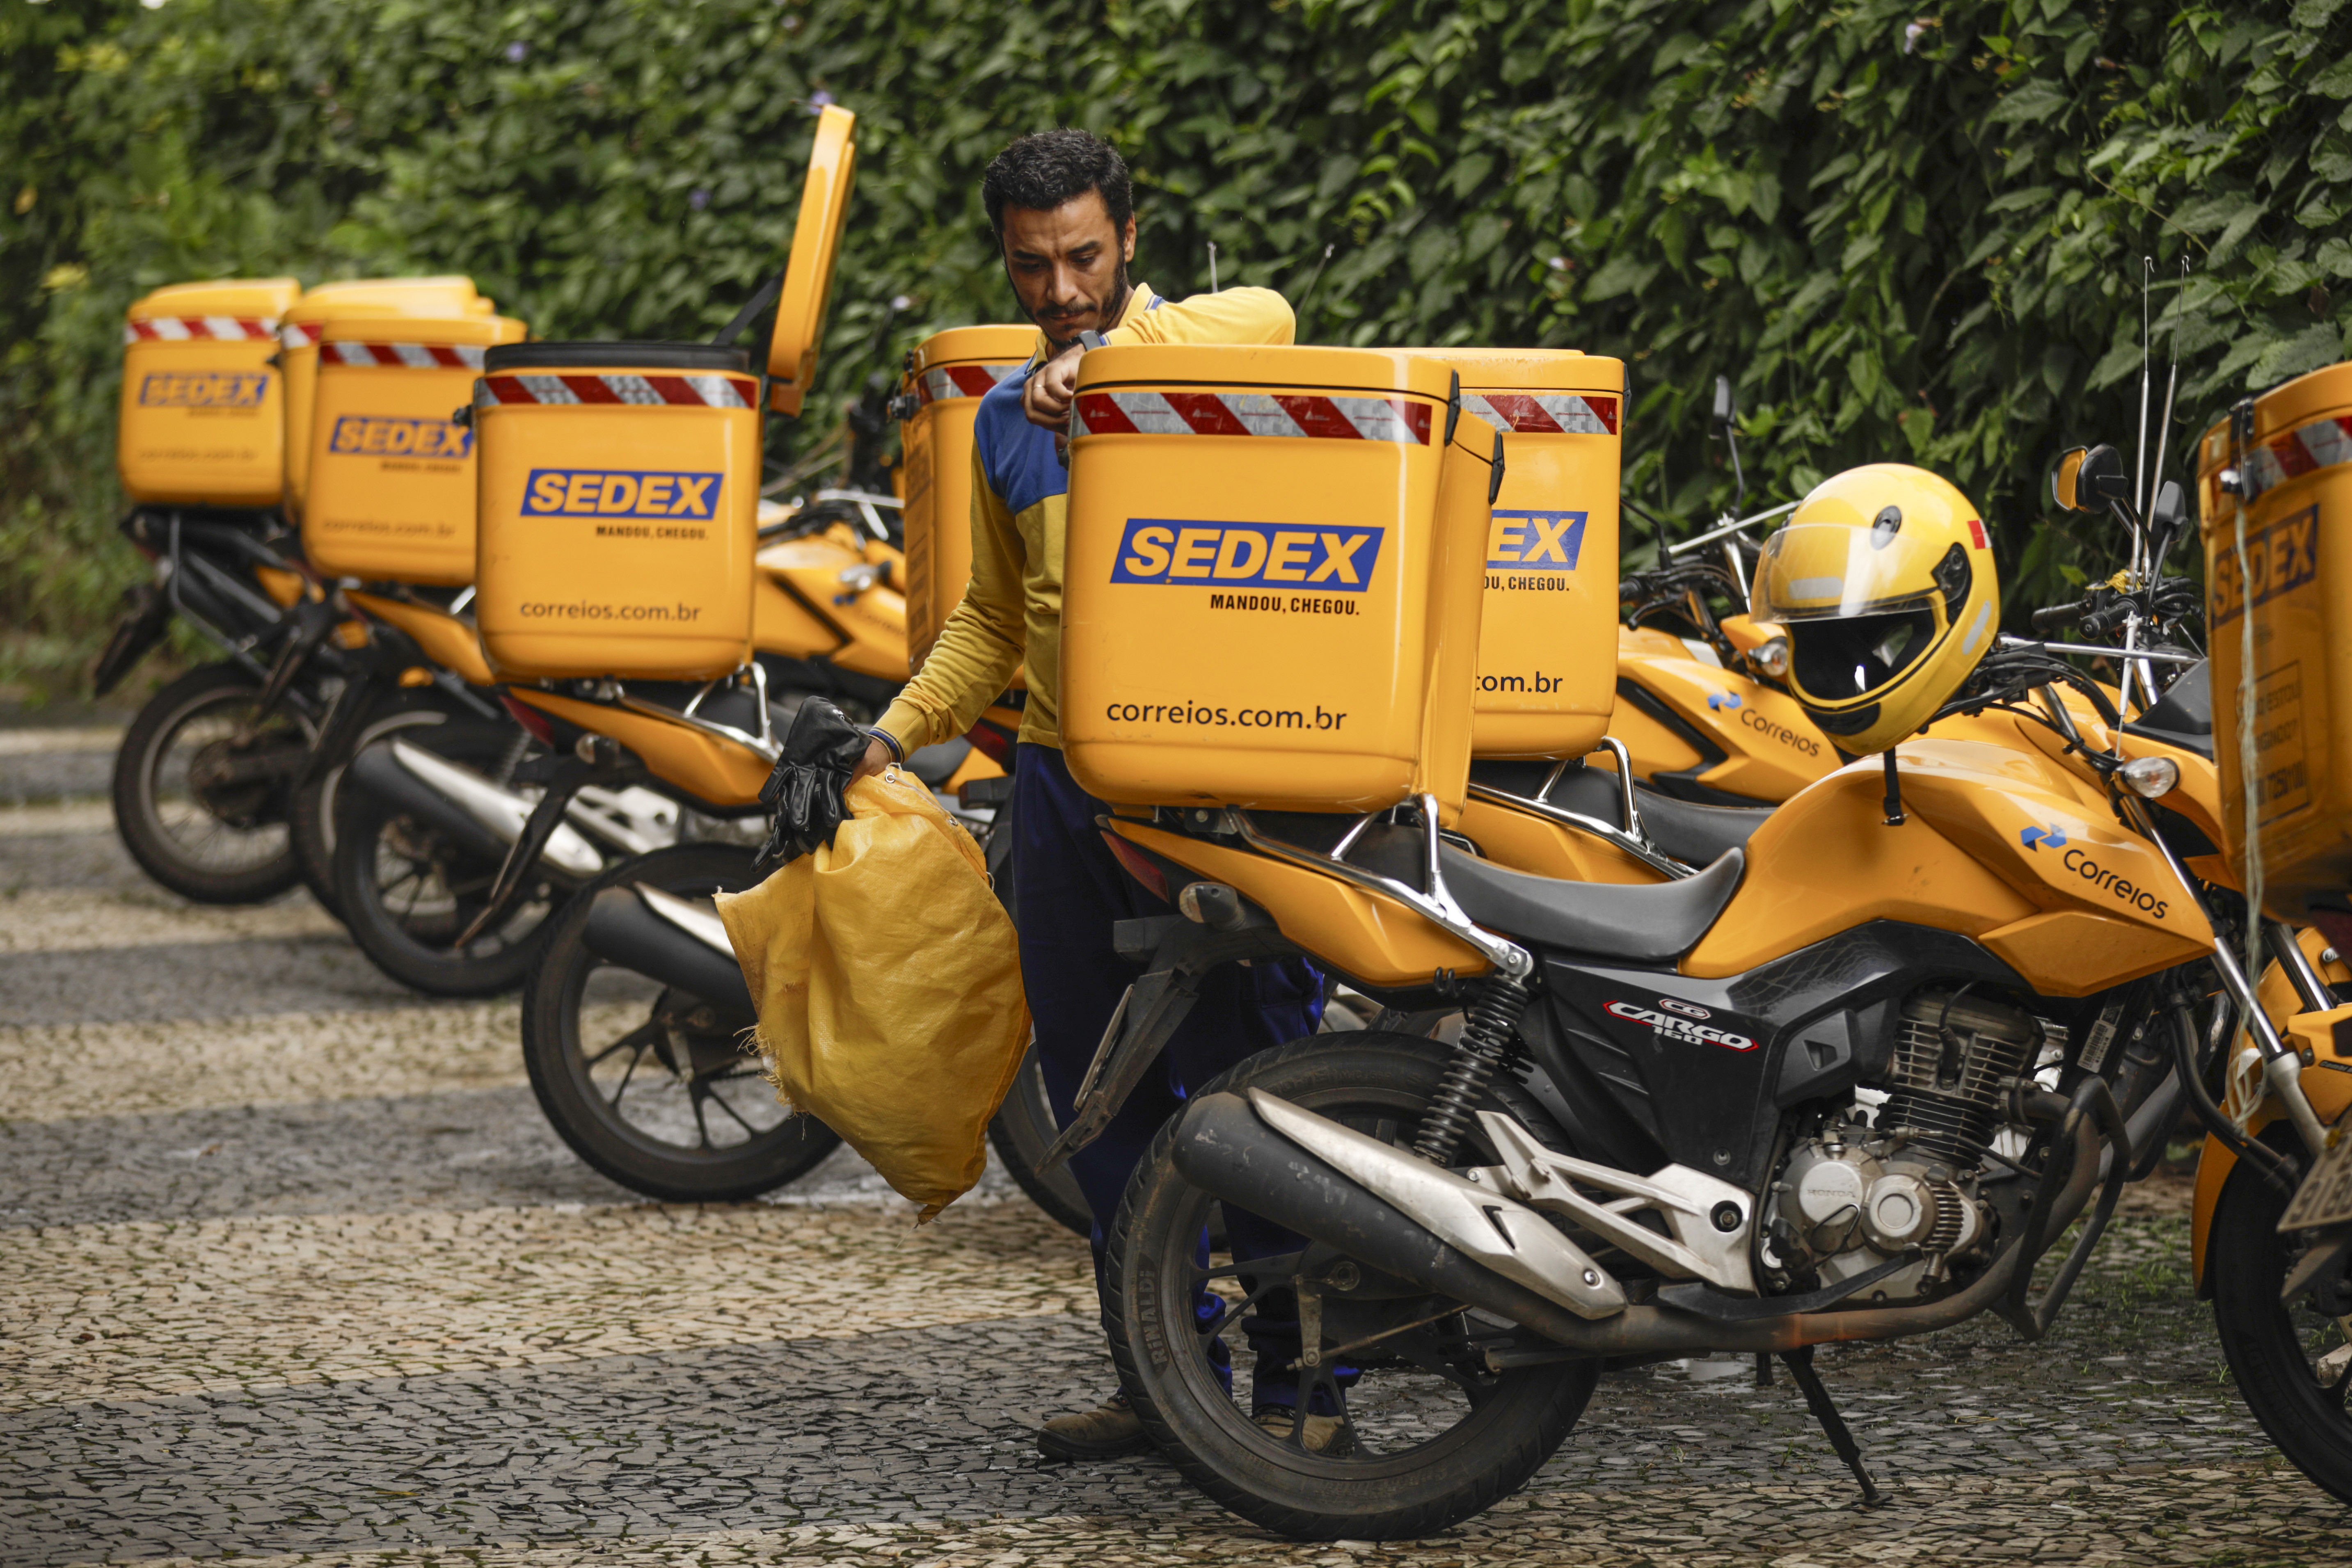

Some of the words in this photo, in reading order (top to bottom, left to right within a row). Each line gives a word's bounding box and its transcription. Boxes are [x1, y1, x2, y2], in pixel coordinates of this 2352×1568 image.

[336, 420, 469, 455] SEDEX
[529, 473, 716, 516] SEDEX
[596, 526, 654, 540] MANDOU,
[657, 527, 709, 541] CHEGOU.
[1124, 526, 1370, 584] SEDEX
[1508, 576, 1570, 592] CHEGOU.
[519, 600, 702, 622] correios.com.br
[1210, 594, 1287, 614] MANDOU,
[1290, 597, 1360, 616] CHEGOU.
[1106, 700, 1347, 730] correios.com.br
[1741, 709, 1821, 757] Correios
[2064, 849, 2169, 919] Correios
[1663, 1000, 1708, 1017] CG
[1608, 1002, 1753, 1050] CARGO
[1652, 1025, 1704, 1046] 160
[1807, 1189, 1856, 1198] HONDA
